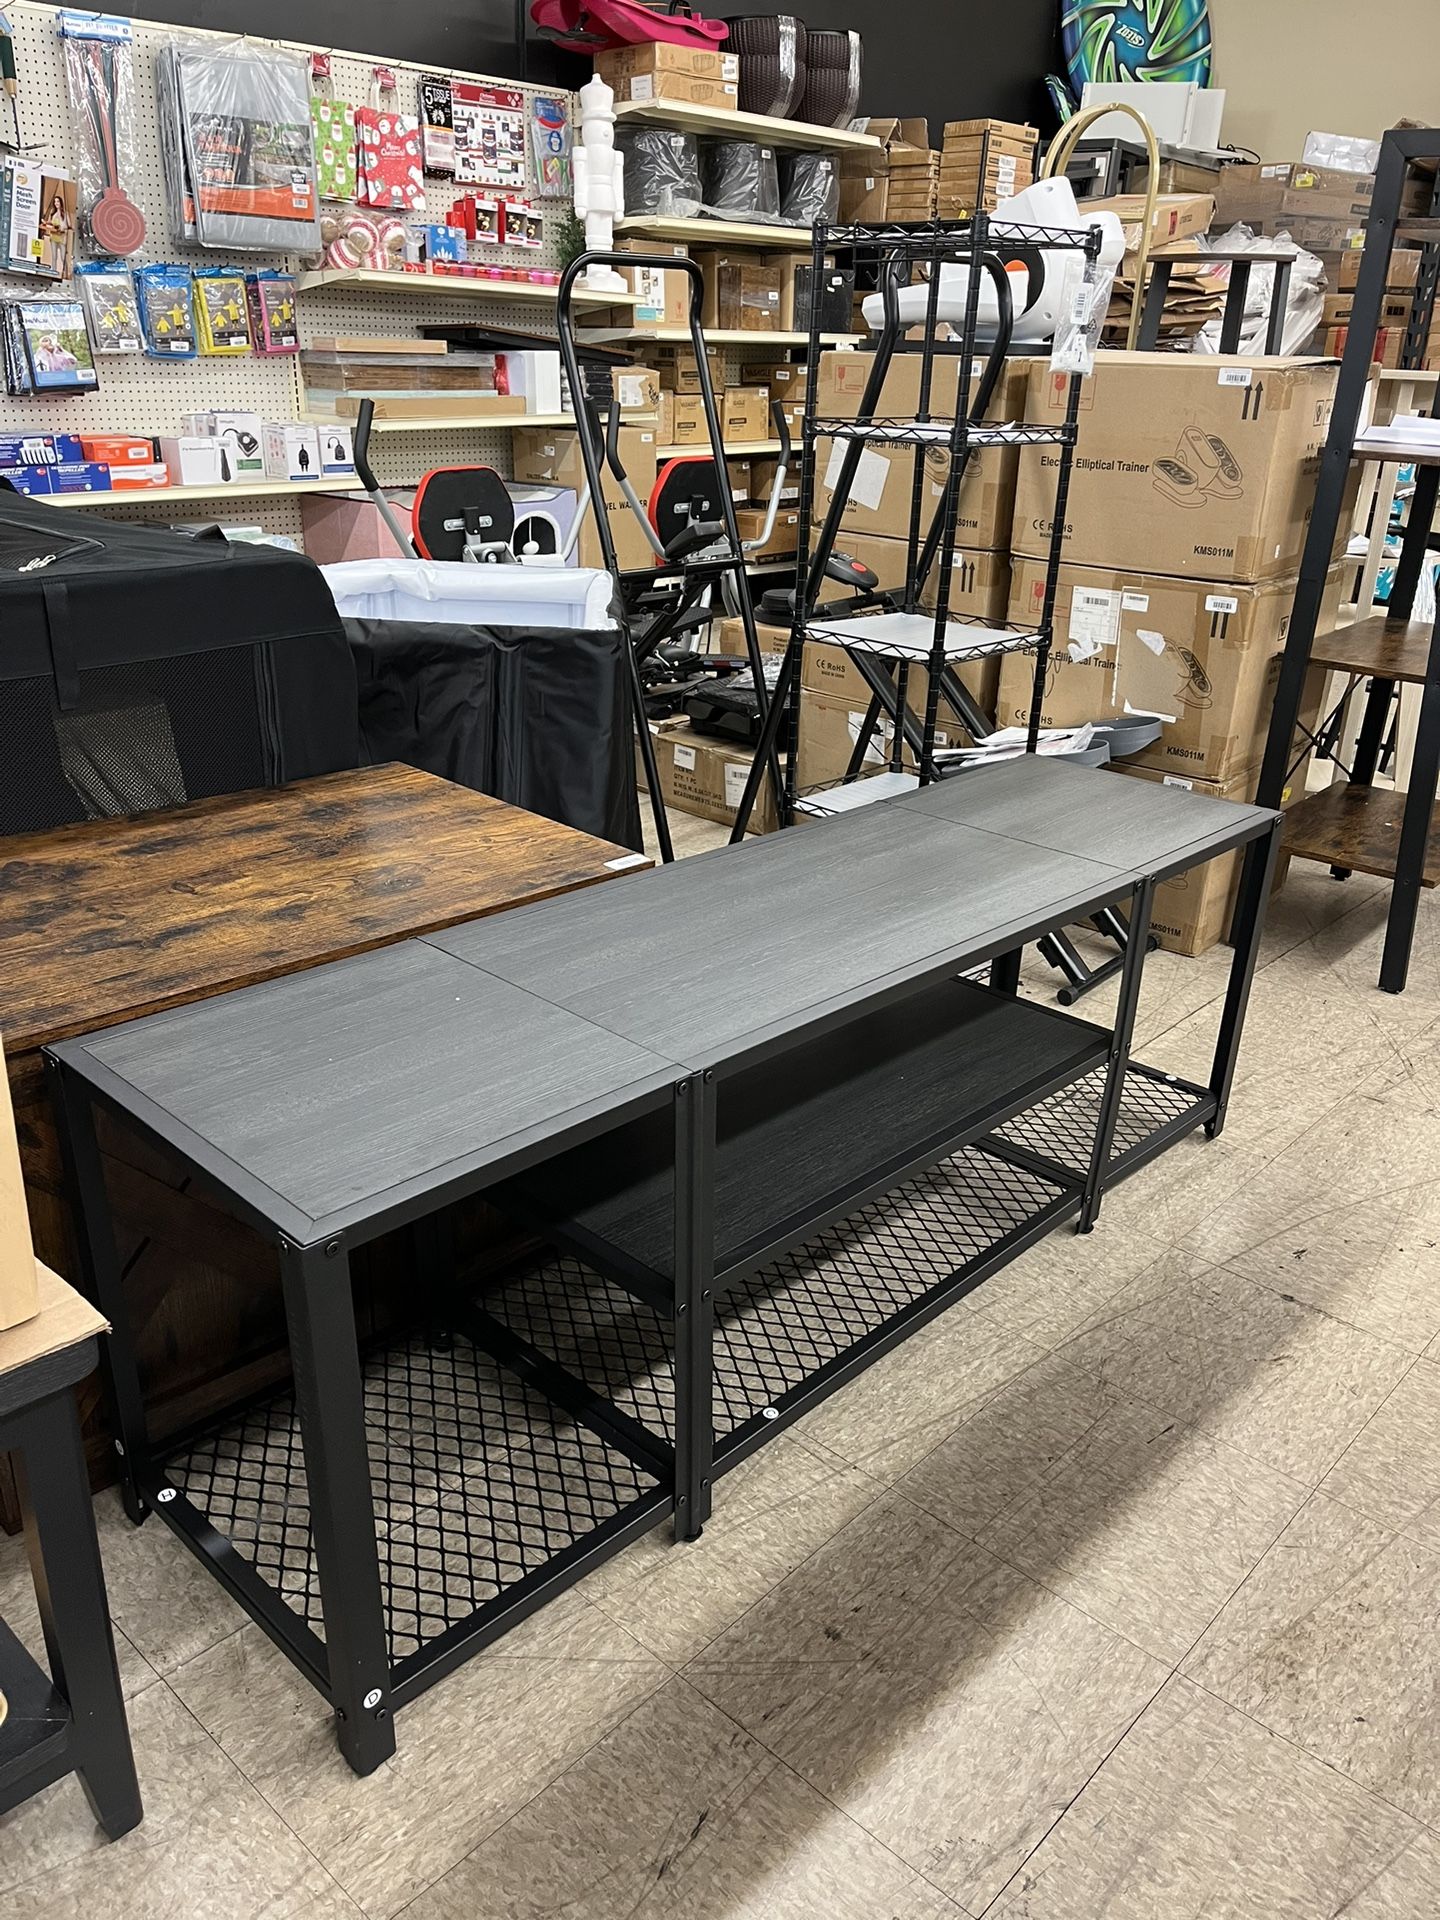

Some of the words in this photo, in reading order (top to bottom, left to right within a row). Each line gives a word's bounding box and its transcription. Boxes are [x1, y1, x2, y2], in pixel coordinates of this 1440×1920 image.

[425, 87, 433, 105] 5
[16, 189, 33, 199] Mesh
[15, 201, 31, 210] Door
[16, 195, 37, 206] Screen
[1076, 458, 1115, 471] Elliptical
[1117, 460, 1150, 473] Trainer
[1193, 545, 1234, 558] KMS011M
[827, 662, 846, 673] RoHS
[1166, 746, 1205, 761] KMS011M
